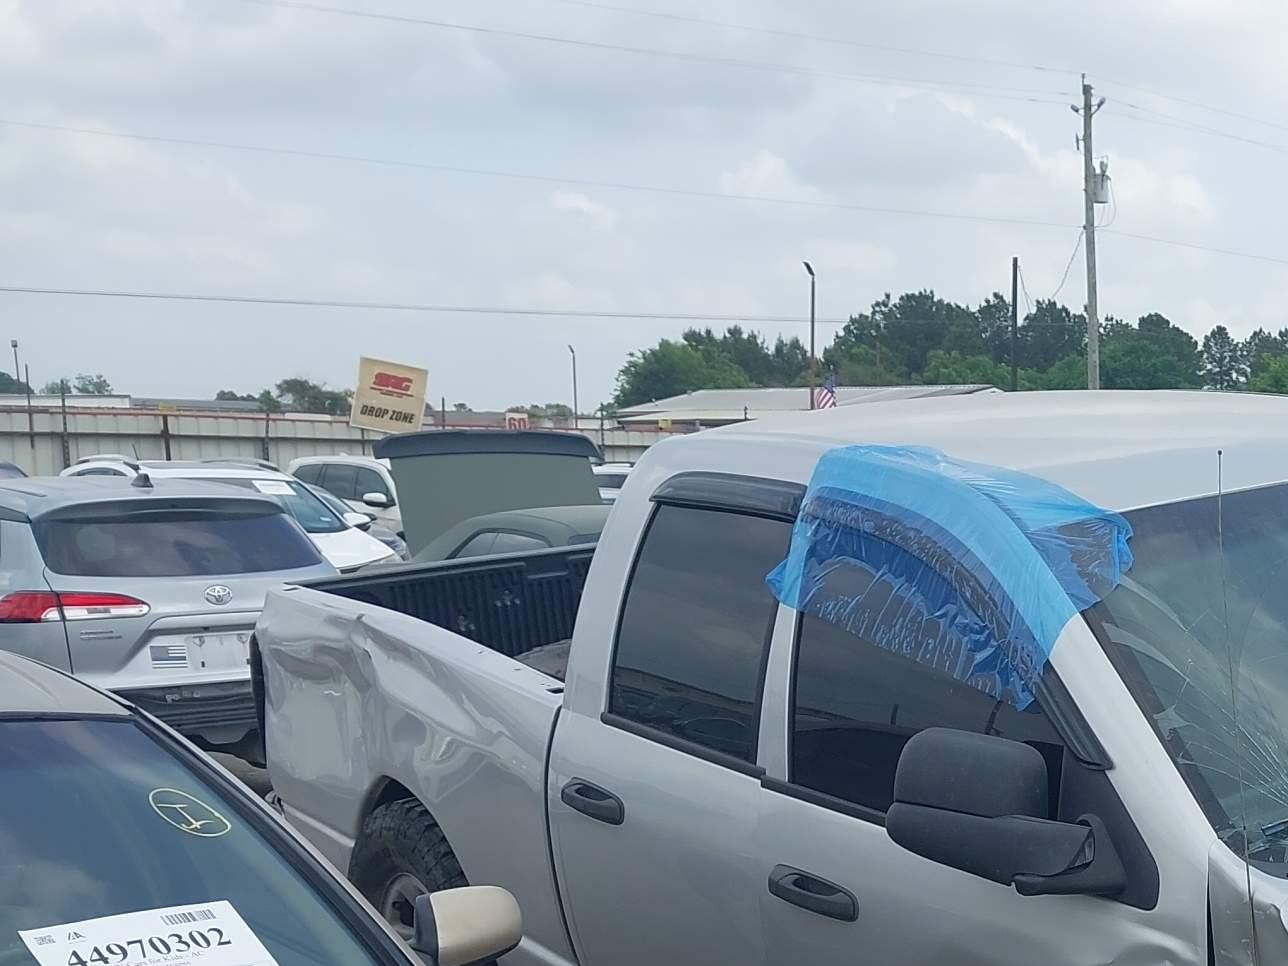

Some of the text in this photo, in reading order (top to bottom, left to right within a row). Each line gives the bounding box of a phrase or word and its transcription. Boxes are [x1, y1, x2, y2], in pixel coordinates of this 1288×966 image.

[360, 404, 416, 425] DROP ZONE
[126, 959, 148, 966] Cars
